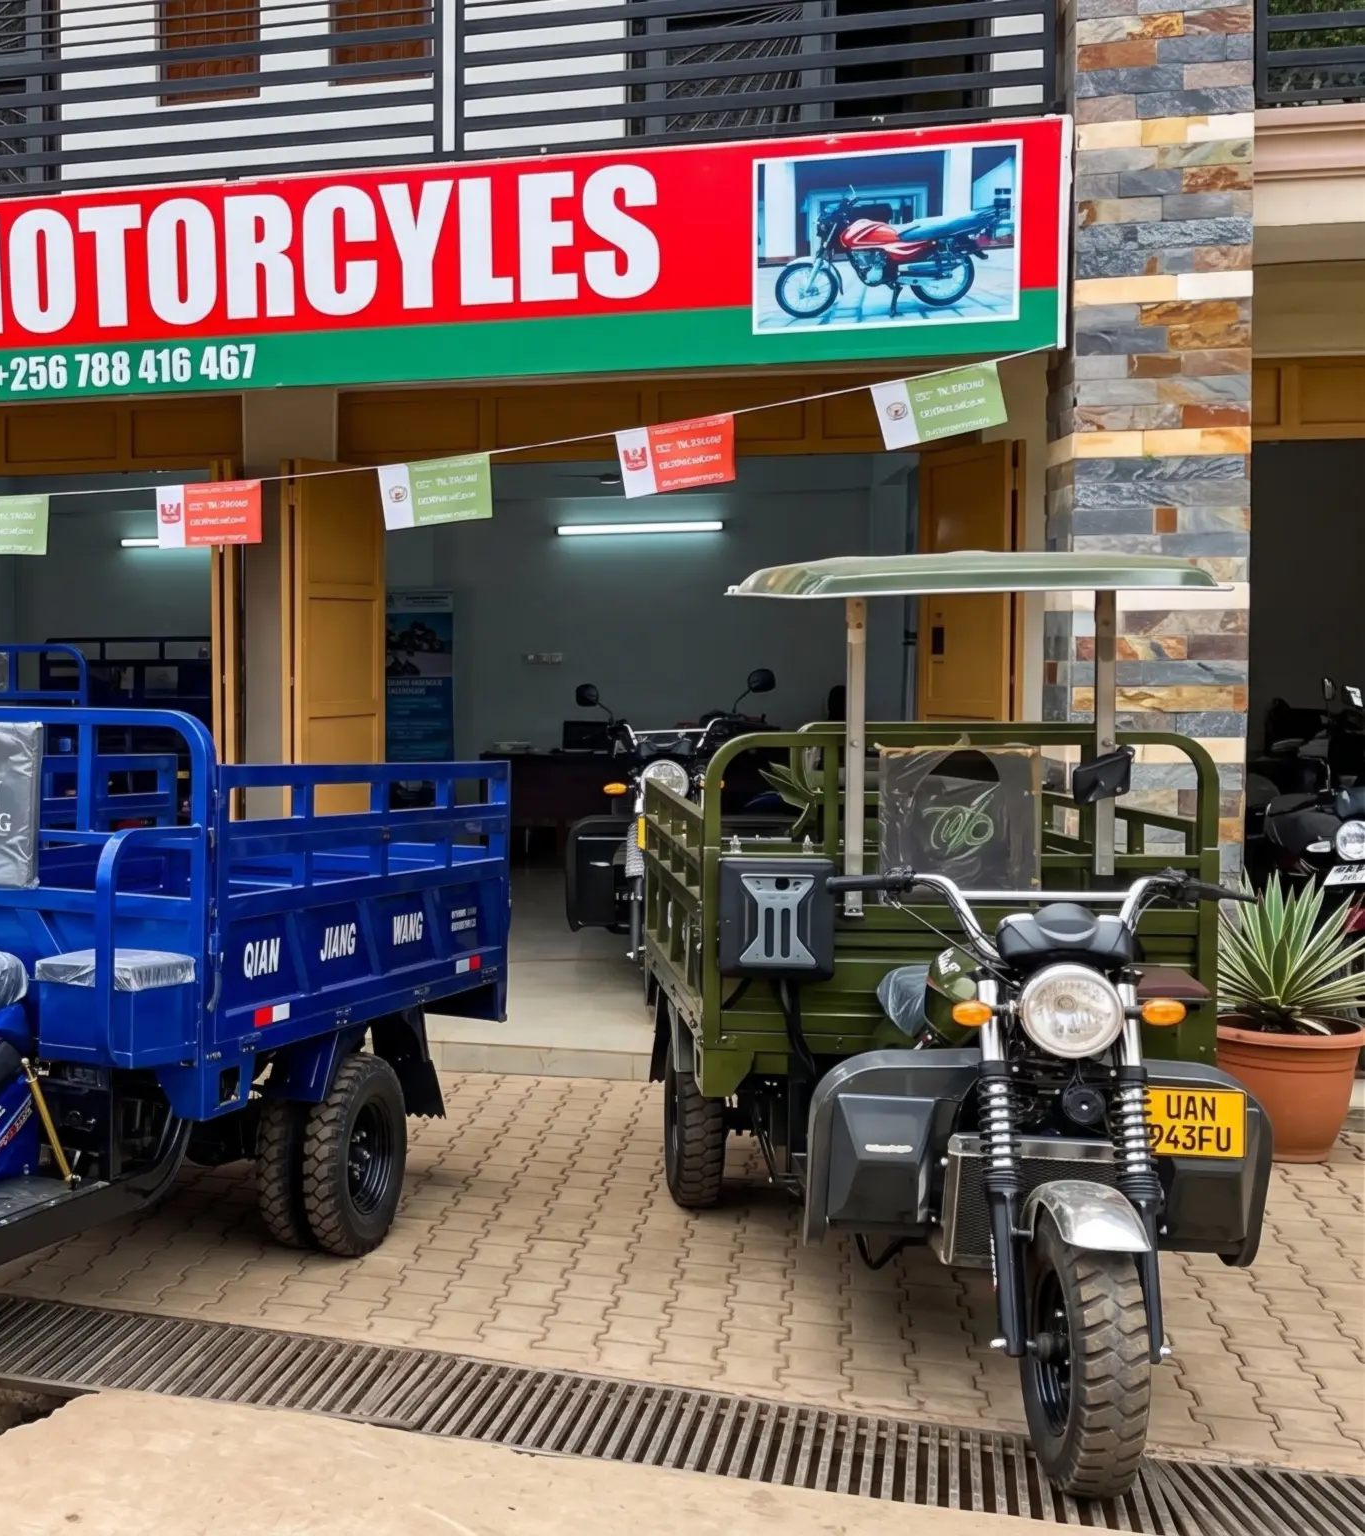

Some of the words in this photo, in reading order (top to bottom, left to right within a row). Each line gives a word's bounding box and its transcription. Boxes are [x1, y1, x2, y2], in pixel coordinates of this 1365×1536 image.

[75, 352, 131, 388] 788
[138, 347, 192, 384] 416
[199, 343, 257, 380] 467
[243, 937, 281, 980] QIAN
[320, 922, 356, 962] JIANG
[393, 911, 424, 946] WANG
[1166, 1094, 1217, 1122] UAN
[1149, 1123, 1232, 1152] 943FU
